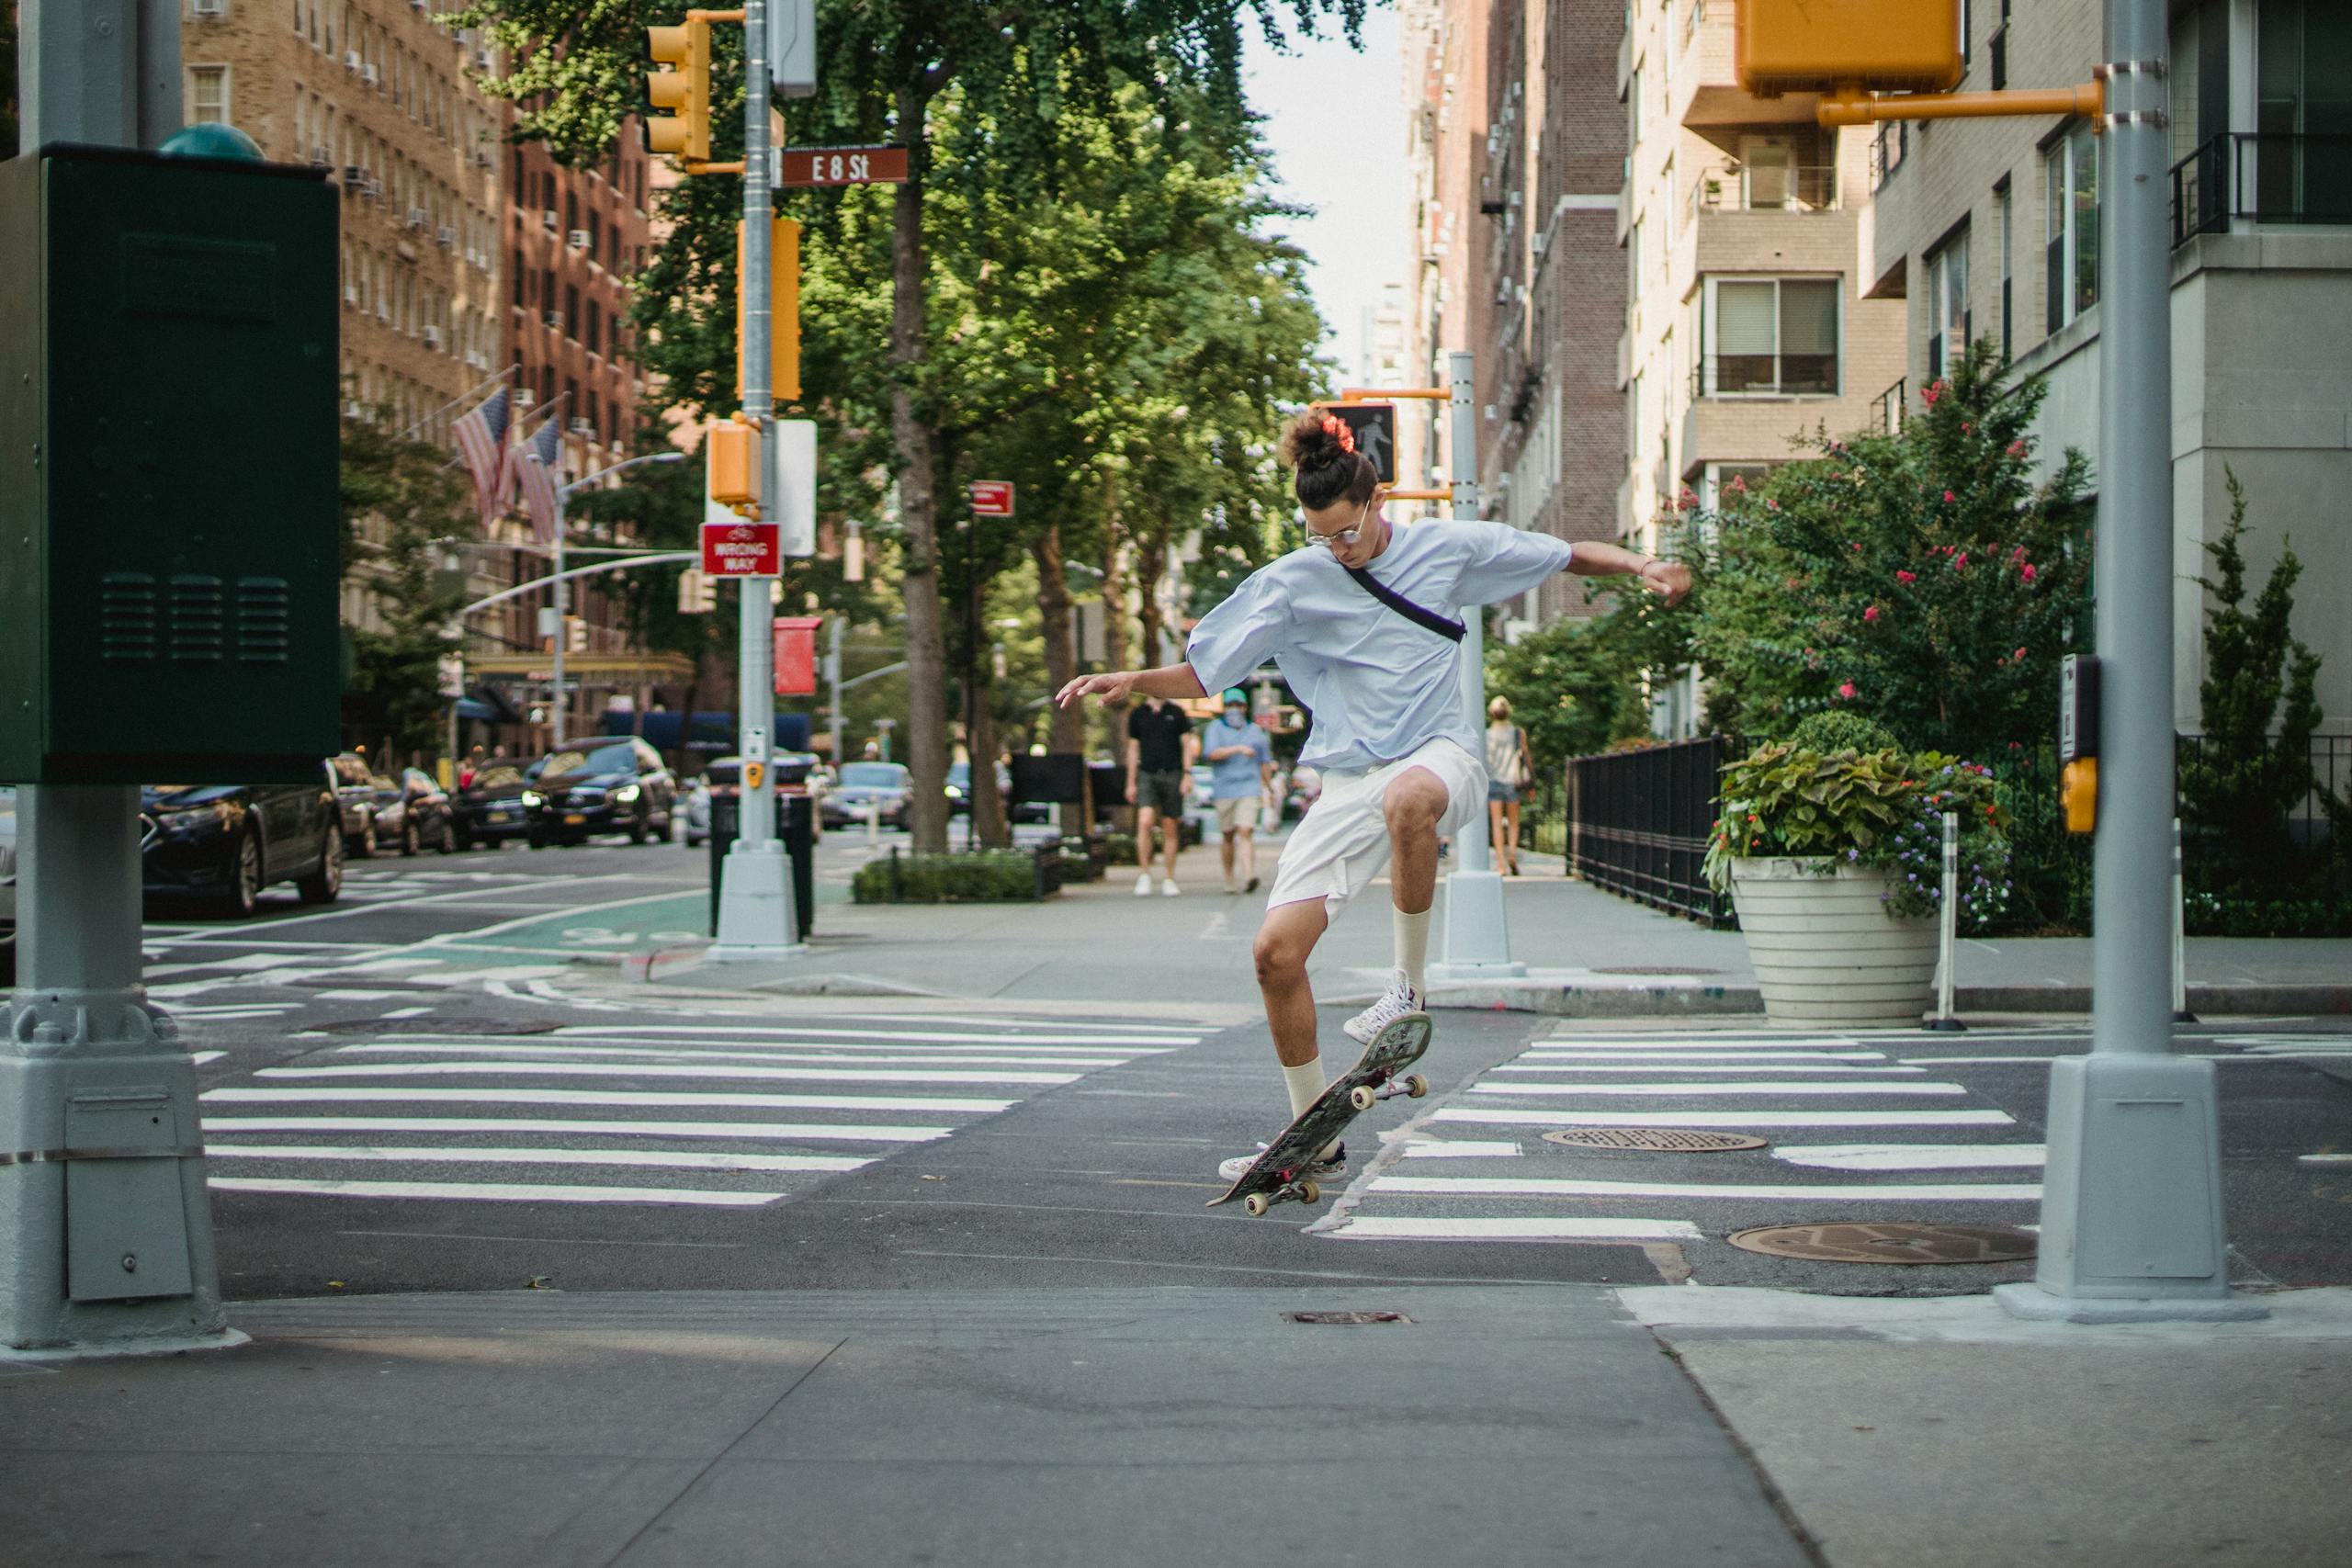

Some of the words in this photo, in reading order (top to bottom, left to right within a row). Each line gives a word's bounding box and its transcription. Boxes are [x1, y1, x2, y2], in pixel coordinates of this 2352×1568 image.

[812, 155, 824, 181] E
[830, 154, 842, 181] 8
[848, 153, 869, 181] St
[714, 542, 768, 556] WRONG
[724, 557, 757, 571] WAY
